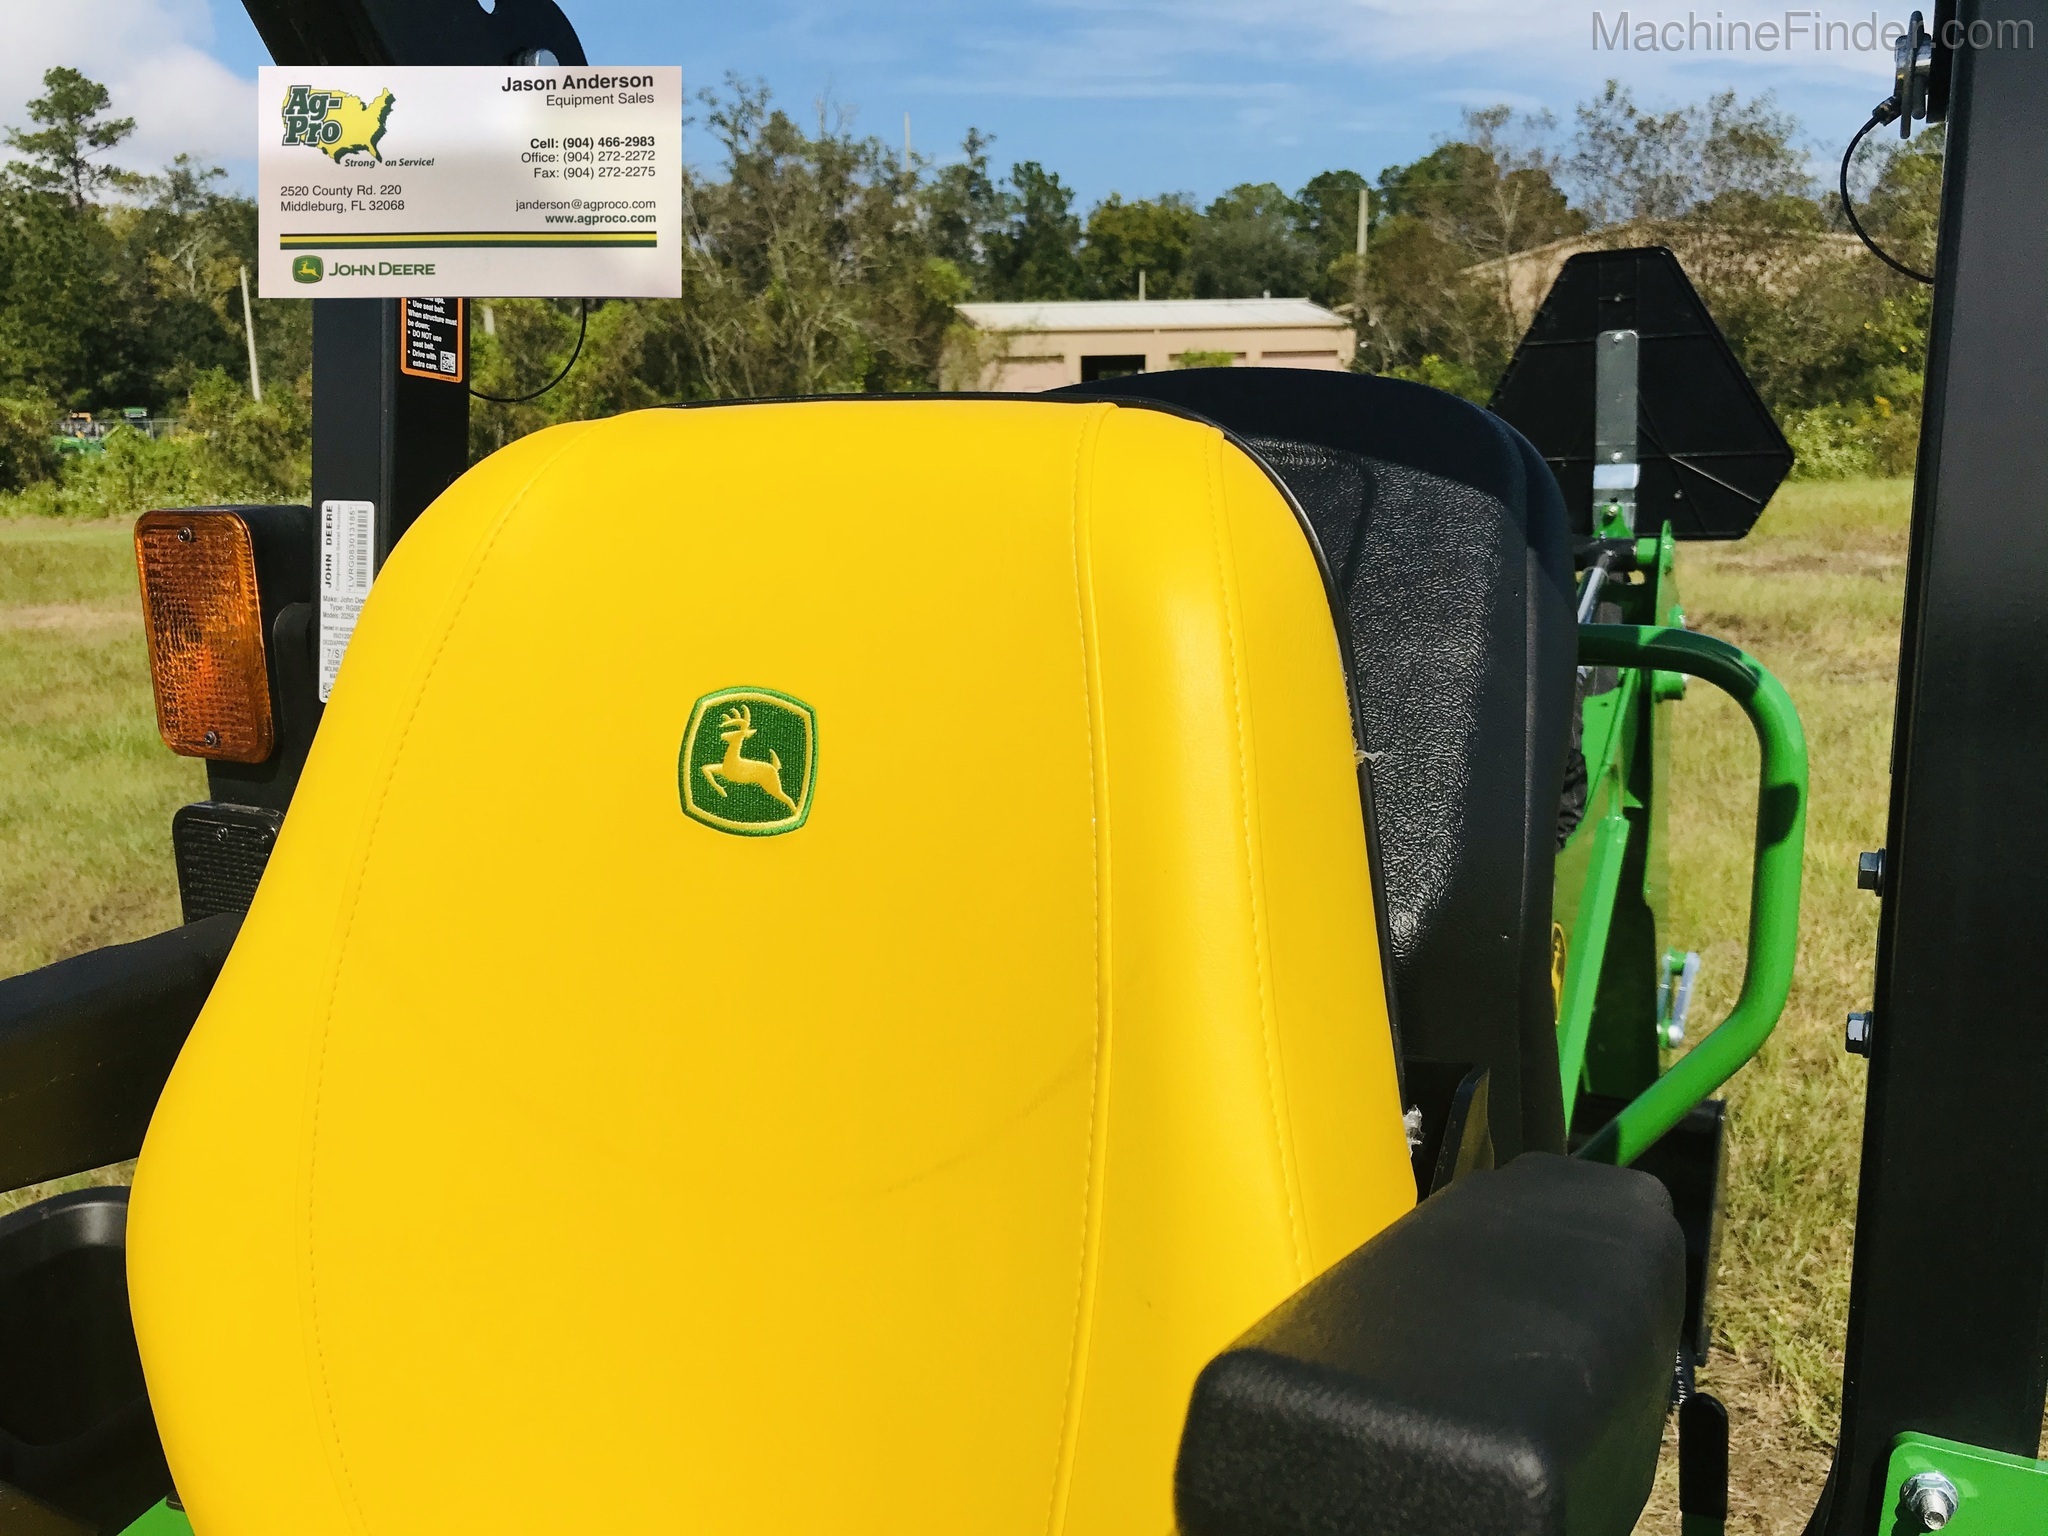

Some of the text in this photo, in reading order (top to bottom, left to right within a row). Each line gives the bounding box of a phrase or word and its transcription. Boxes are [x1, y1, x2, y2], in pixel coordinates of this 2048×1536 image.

[412, 300, 422, 309] Use
[423, 303, 433, 311] seat
[408, 309, 422, 318] When
[423, 313, 444, 323] structure
[412, 330, 442, 342] DO NOT use
[424, 342, 435, 350] belt.
[412, 350, 436, 360] Drive with
